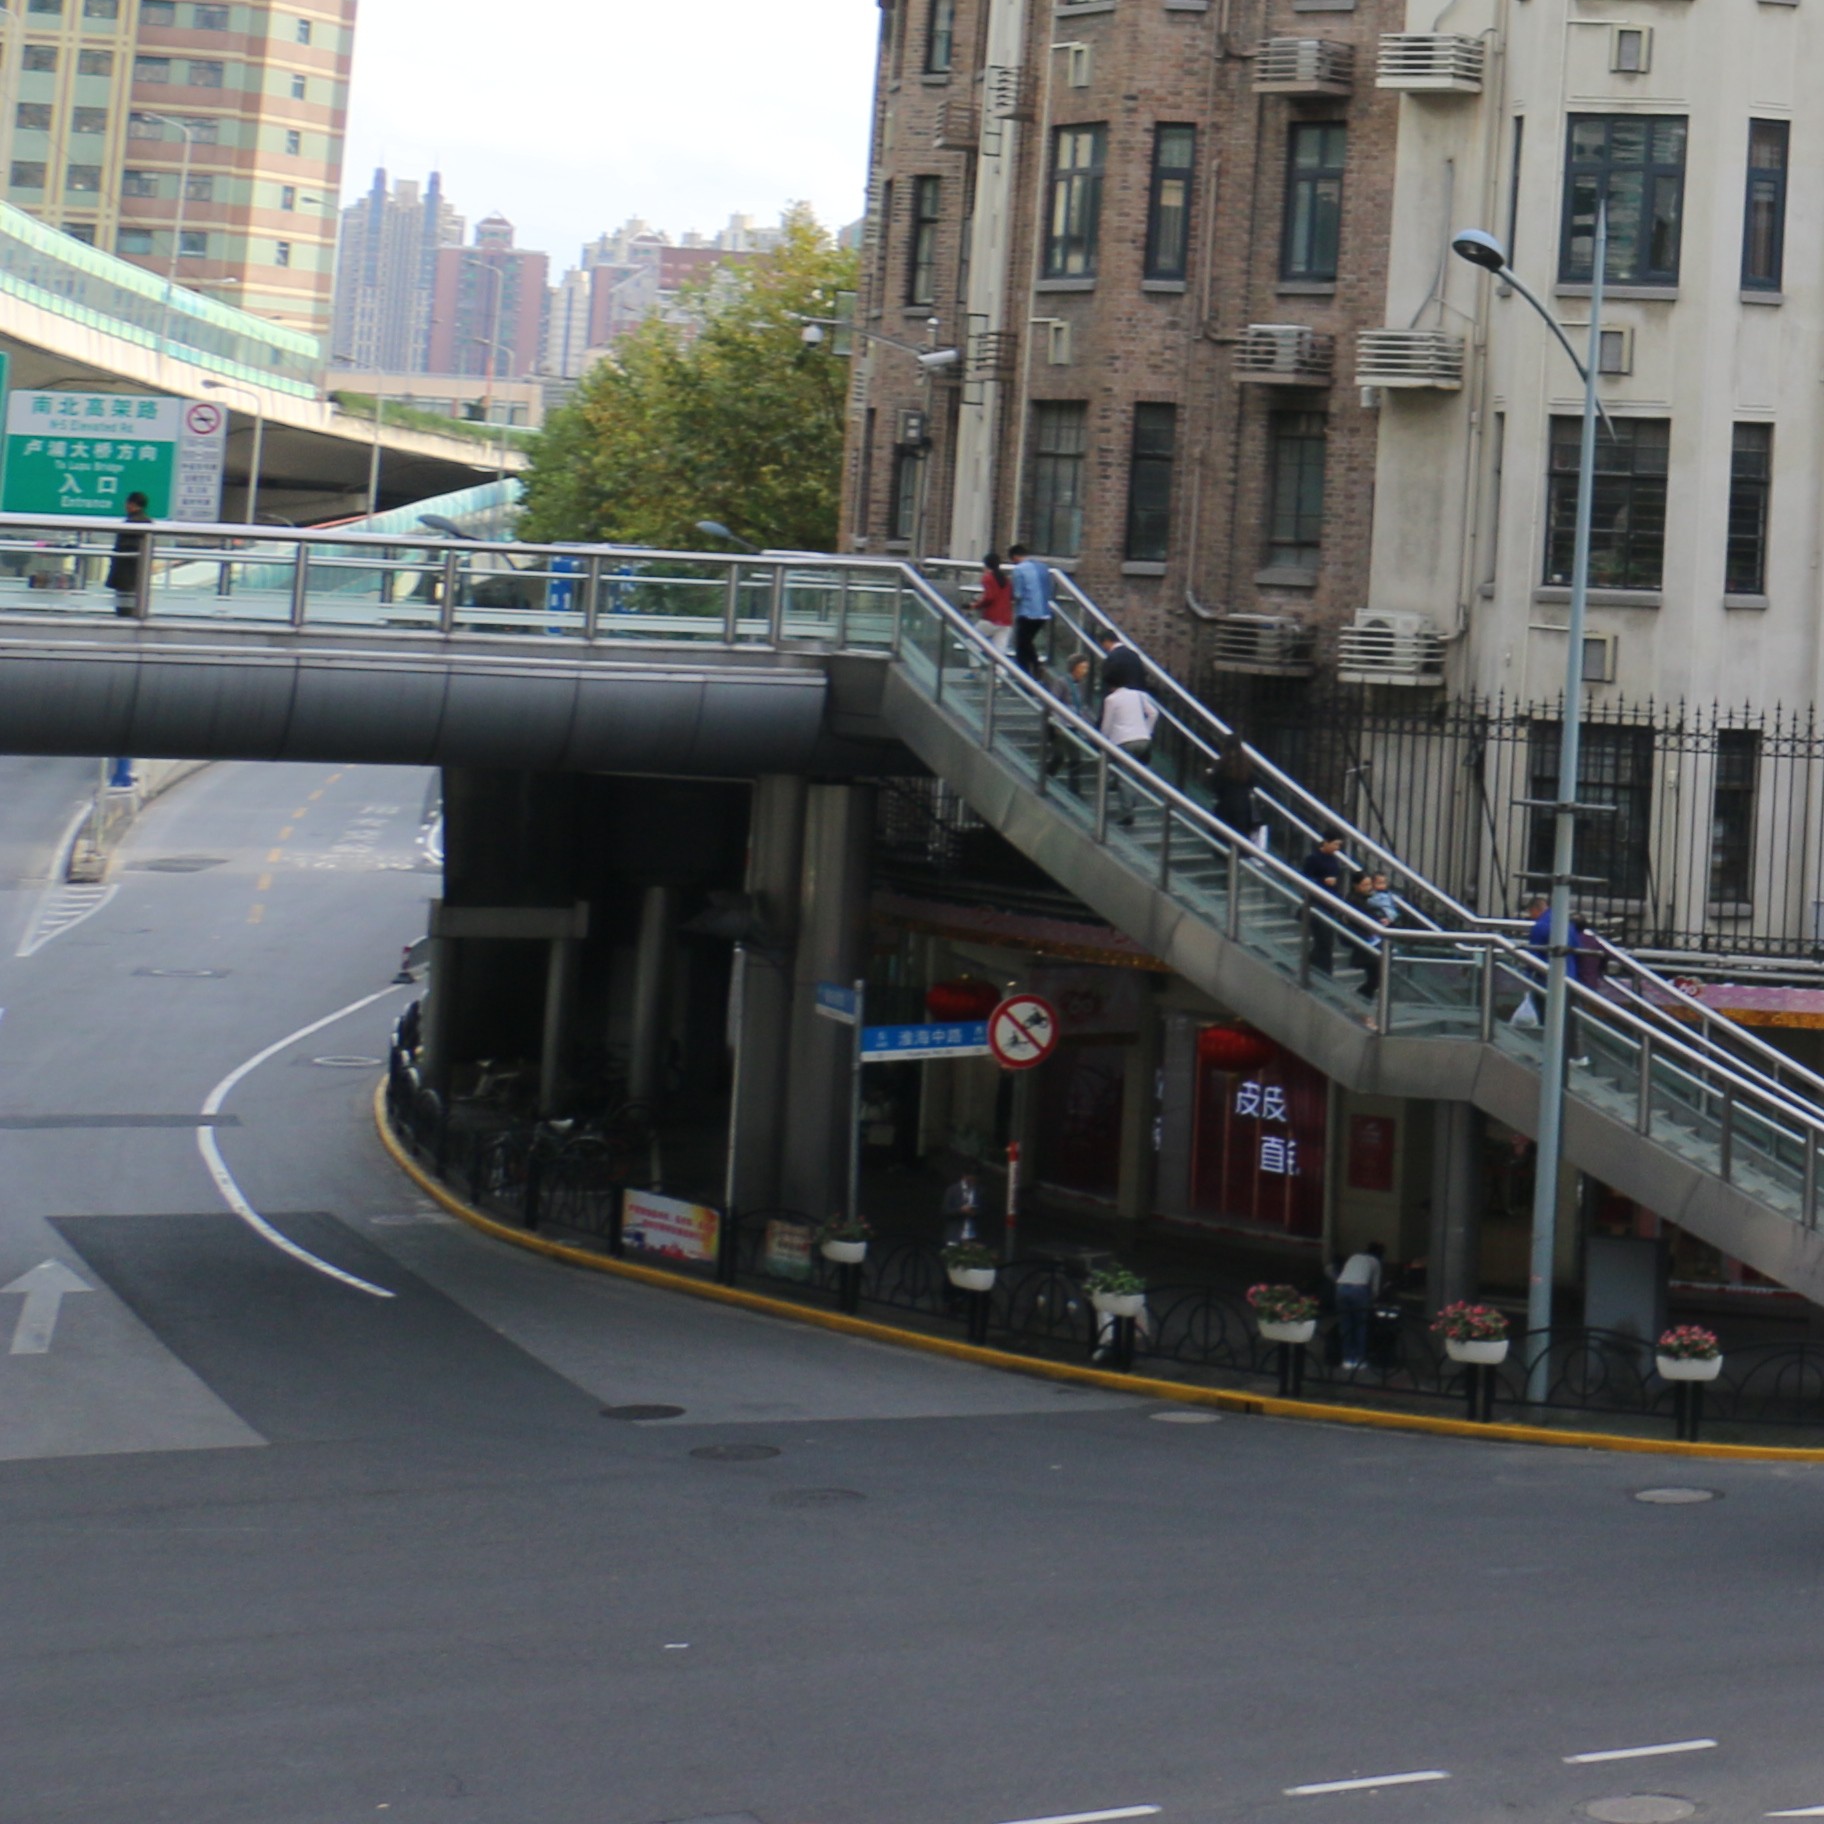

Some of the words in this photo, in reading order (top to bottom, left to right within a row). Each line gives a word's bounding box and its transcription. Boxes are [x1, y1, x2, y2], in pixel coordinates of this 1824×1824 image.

[32, 395, 158, 420] 南北高架路
[23, 439, 158, 461] 卢浦大桥方向
[57, 473, 118, 494] 入口
[898, 1028, 963, 1046] 淮海中路
[1236, 1080, 1288, 1122] 皮皮
